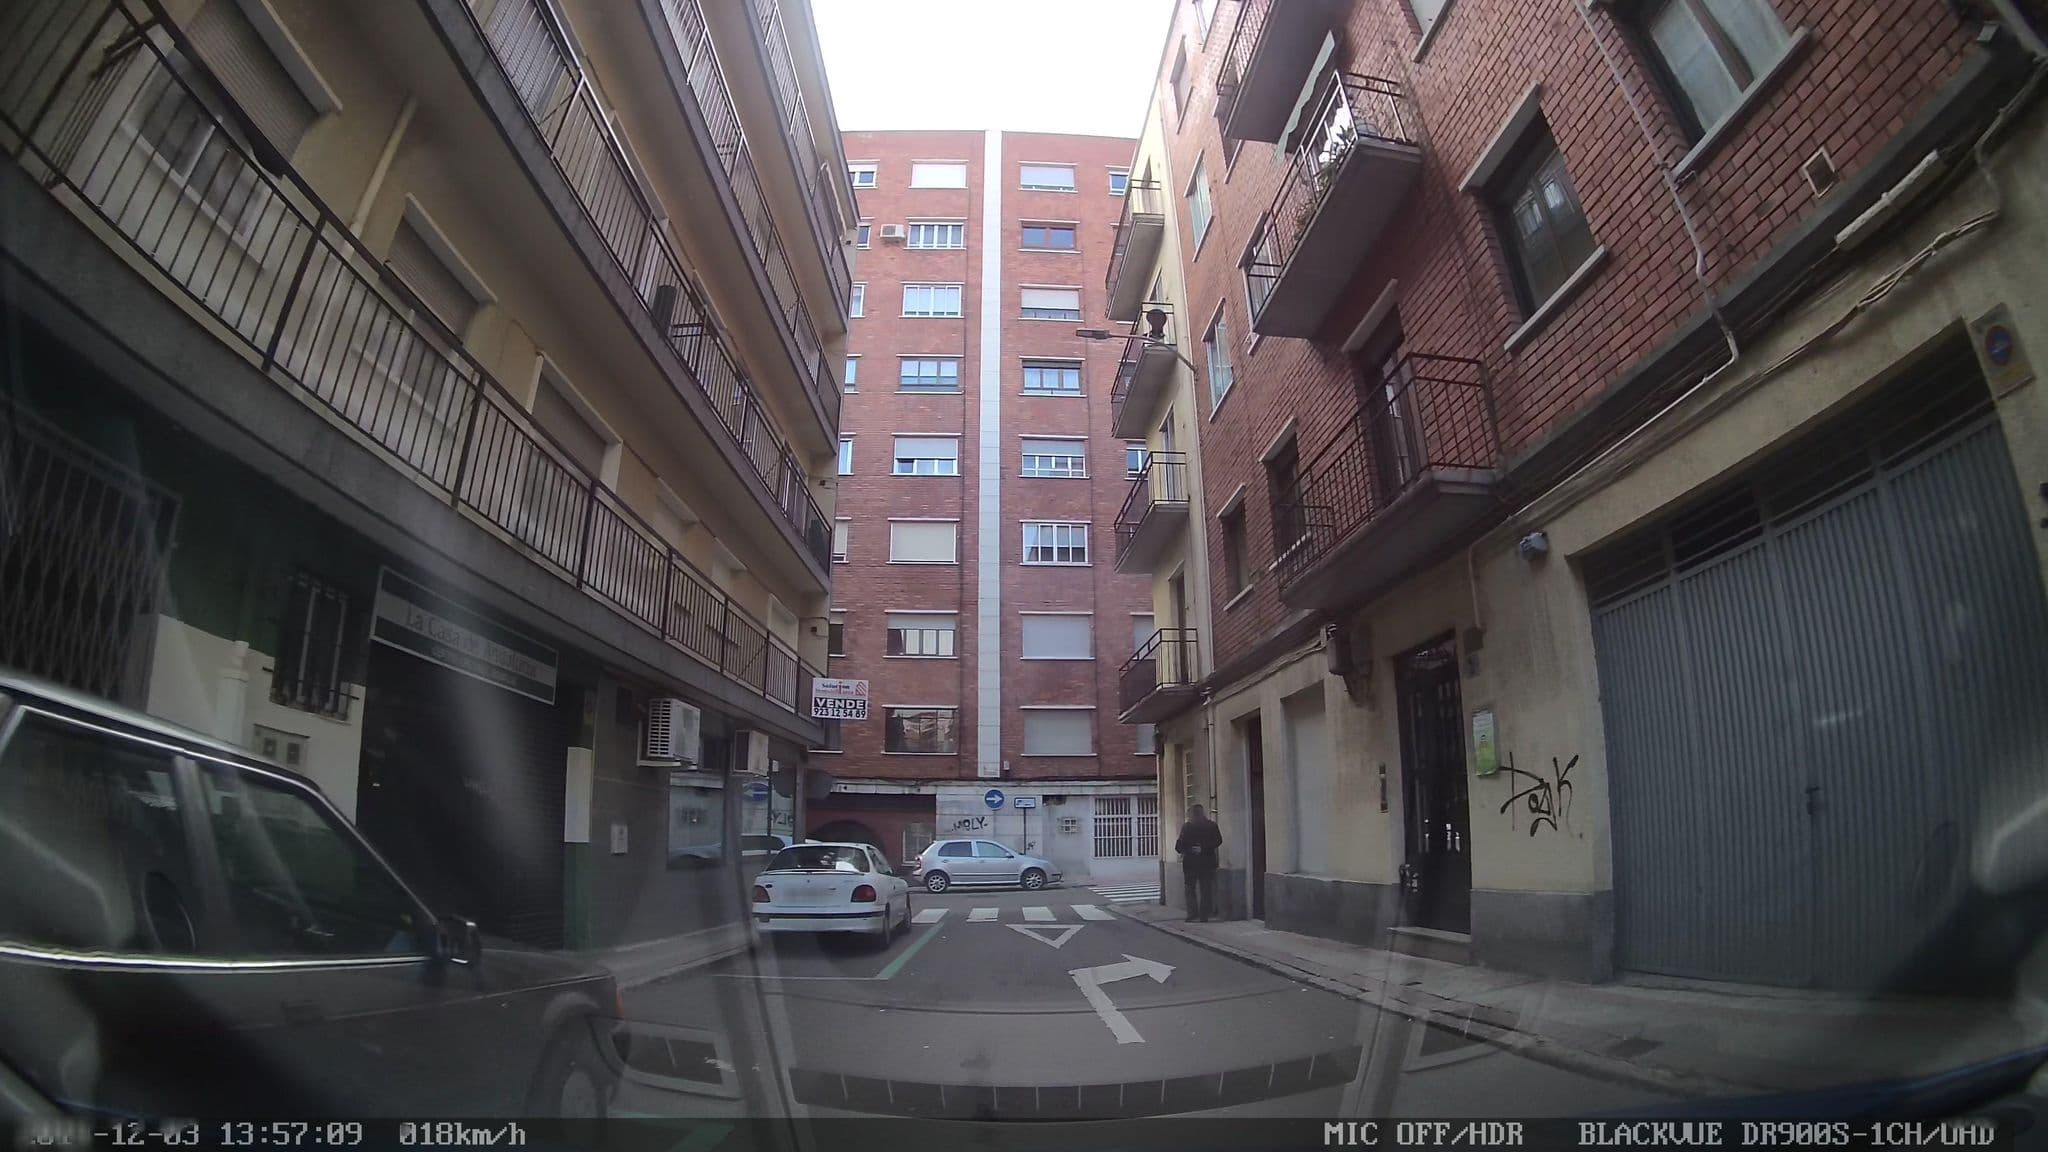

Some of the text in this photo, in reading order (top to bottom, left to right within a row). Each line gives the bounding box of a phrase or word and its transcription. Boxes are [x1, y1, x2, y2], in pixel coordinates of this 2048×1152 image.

[816, 698, 865, 709] VENDE
[814, 707, 829, 716] 923
[831, 709, 840, 717] 12
[843, 709, 853, 718] 54
